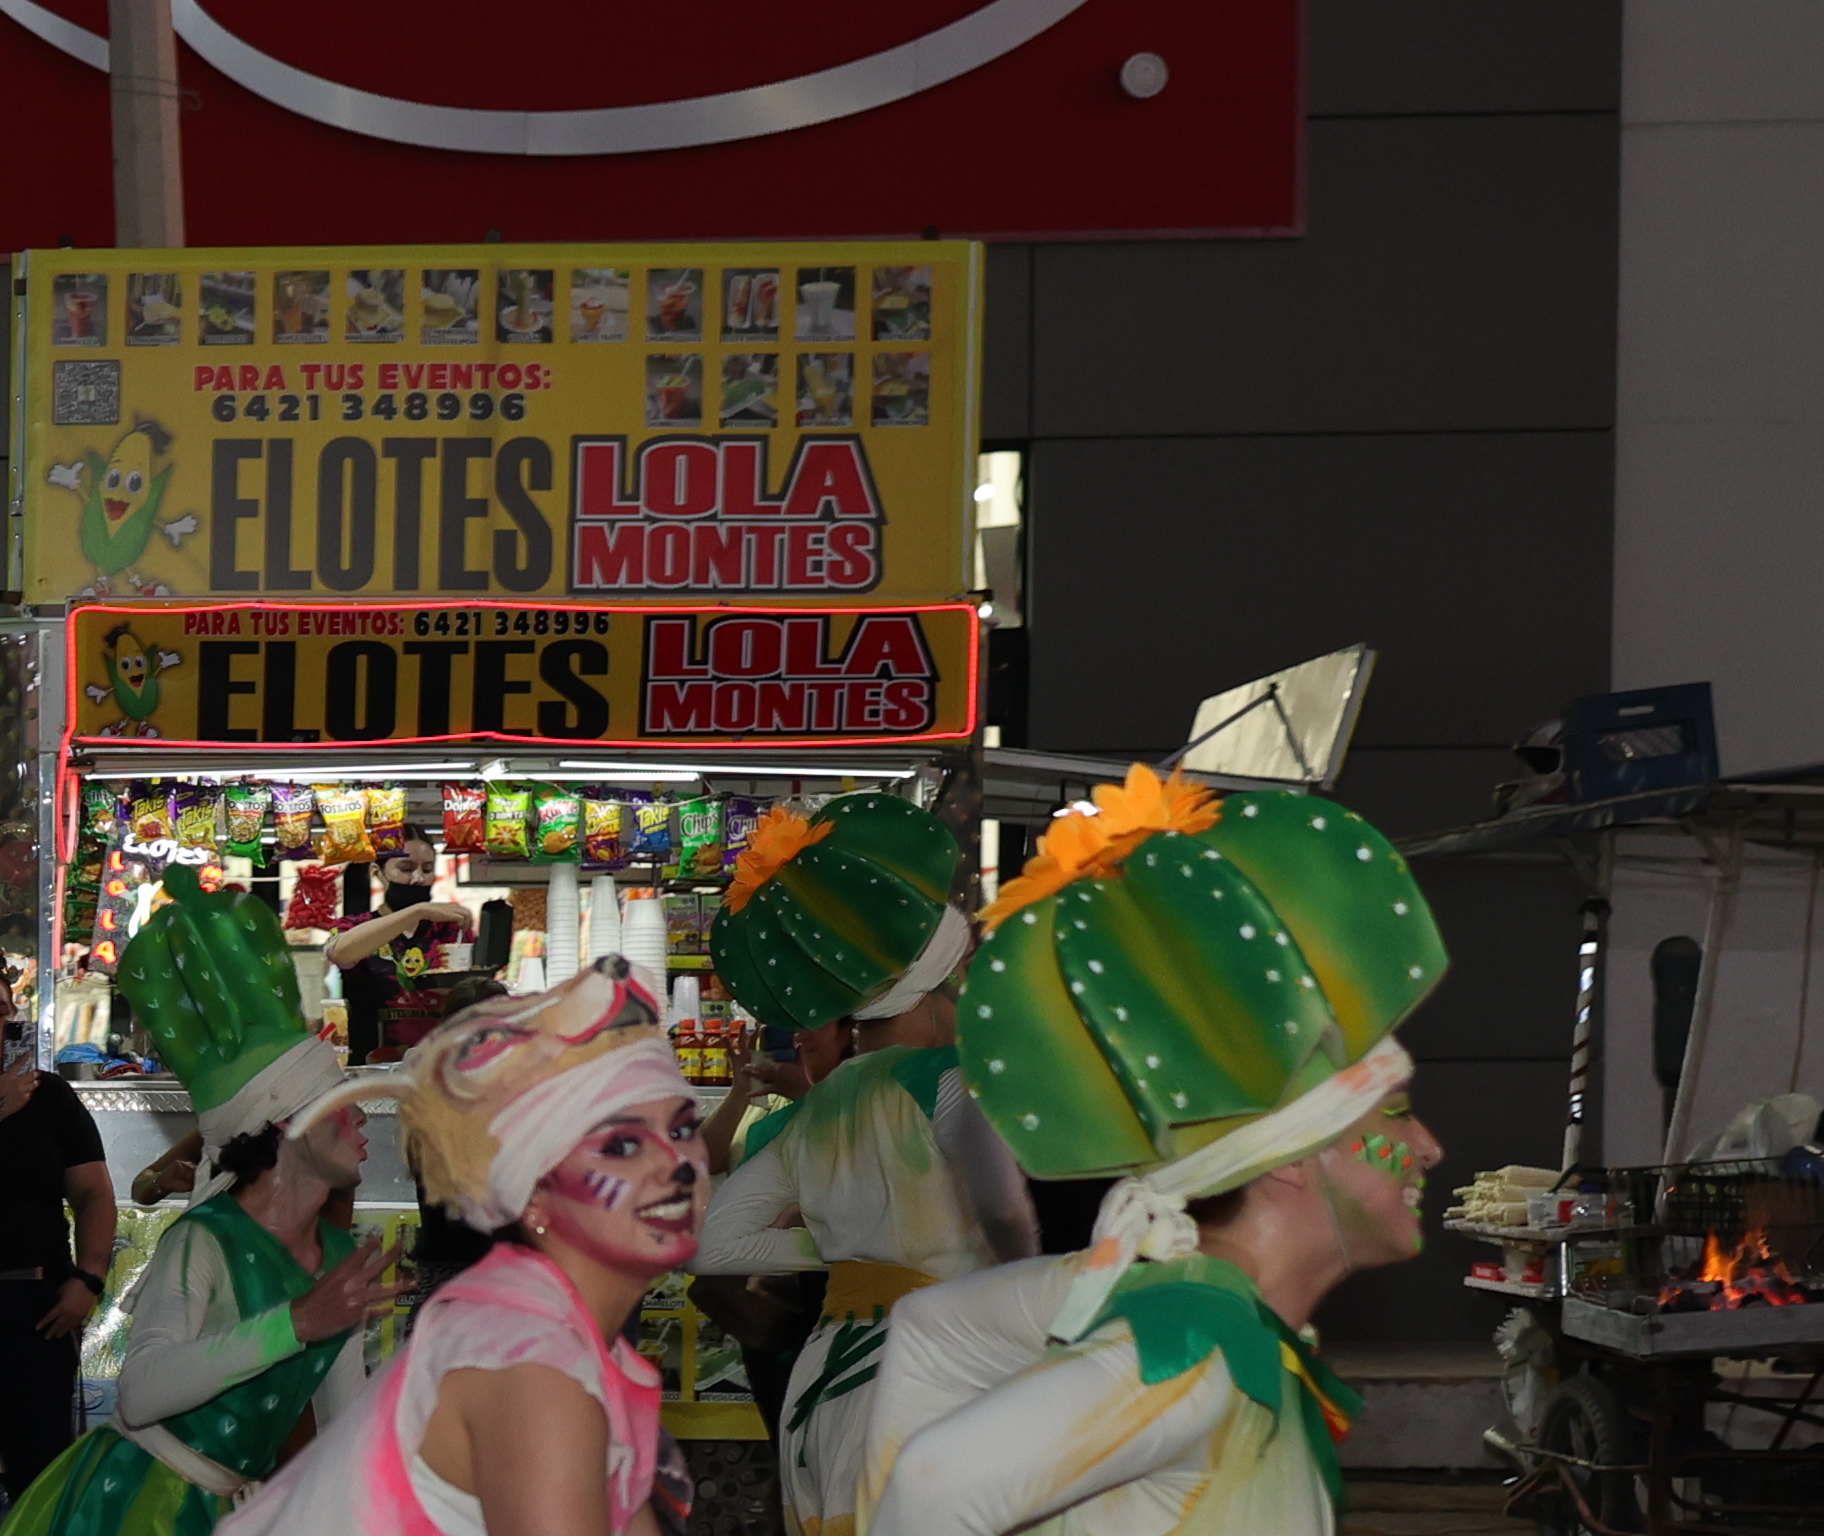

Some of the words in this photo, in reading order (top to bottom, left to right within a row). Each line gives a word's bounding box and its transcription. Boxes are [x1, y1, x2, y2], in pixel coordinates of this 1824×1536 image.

[193, 364, 286, 392] PARA
[300, 363, 365, 391] TUS
[378, 362, 552, 391] EVENTOS:
[211, 393, 321, 422] 6421
[340, 392, 526, 422] 348996
[573, 436, 884, 523] LOLA
[209, 435, 552, 594] ELOTES
[572, 519, 878, 592] MONTES
[184, 612, 236, 636] PARA
[241, 612, 290, 636] TUS
[296, 612, 405, 636] EVENTOS:
[412, 611, 486, 636] 6421
[494, 611, 610, 636] 348996
[644, 615, 938, 682] LOLA
[197, 641, 610, 742] ELOTES
[644, 679, 934, 734] MONTES
